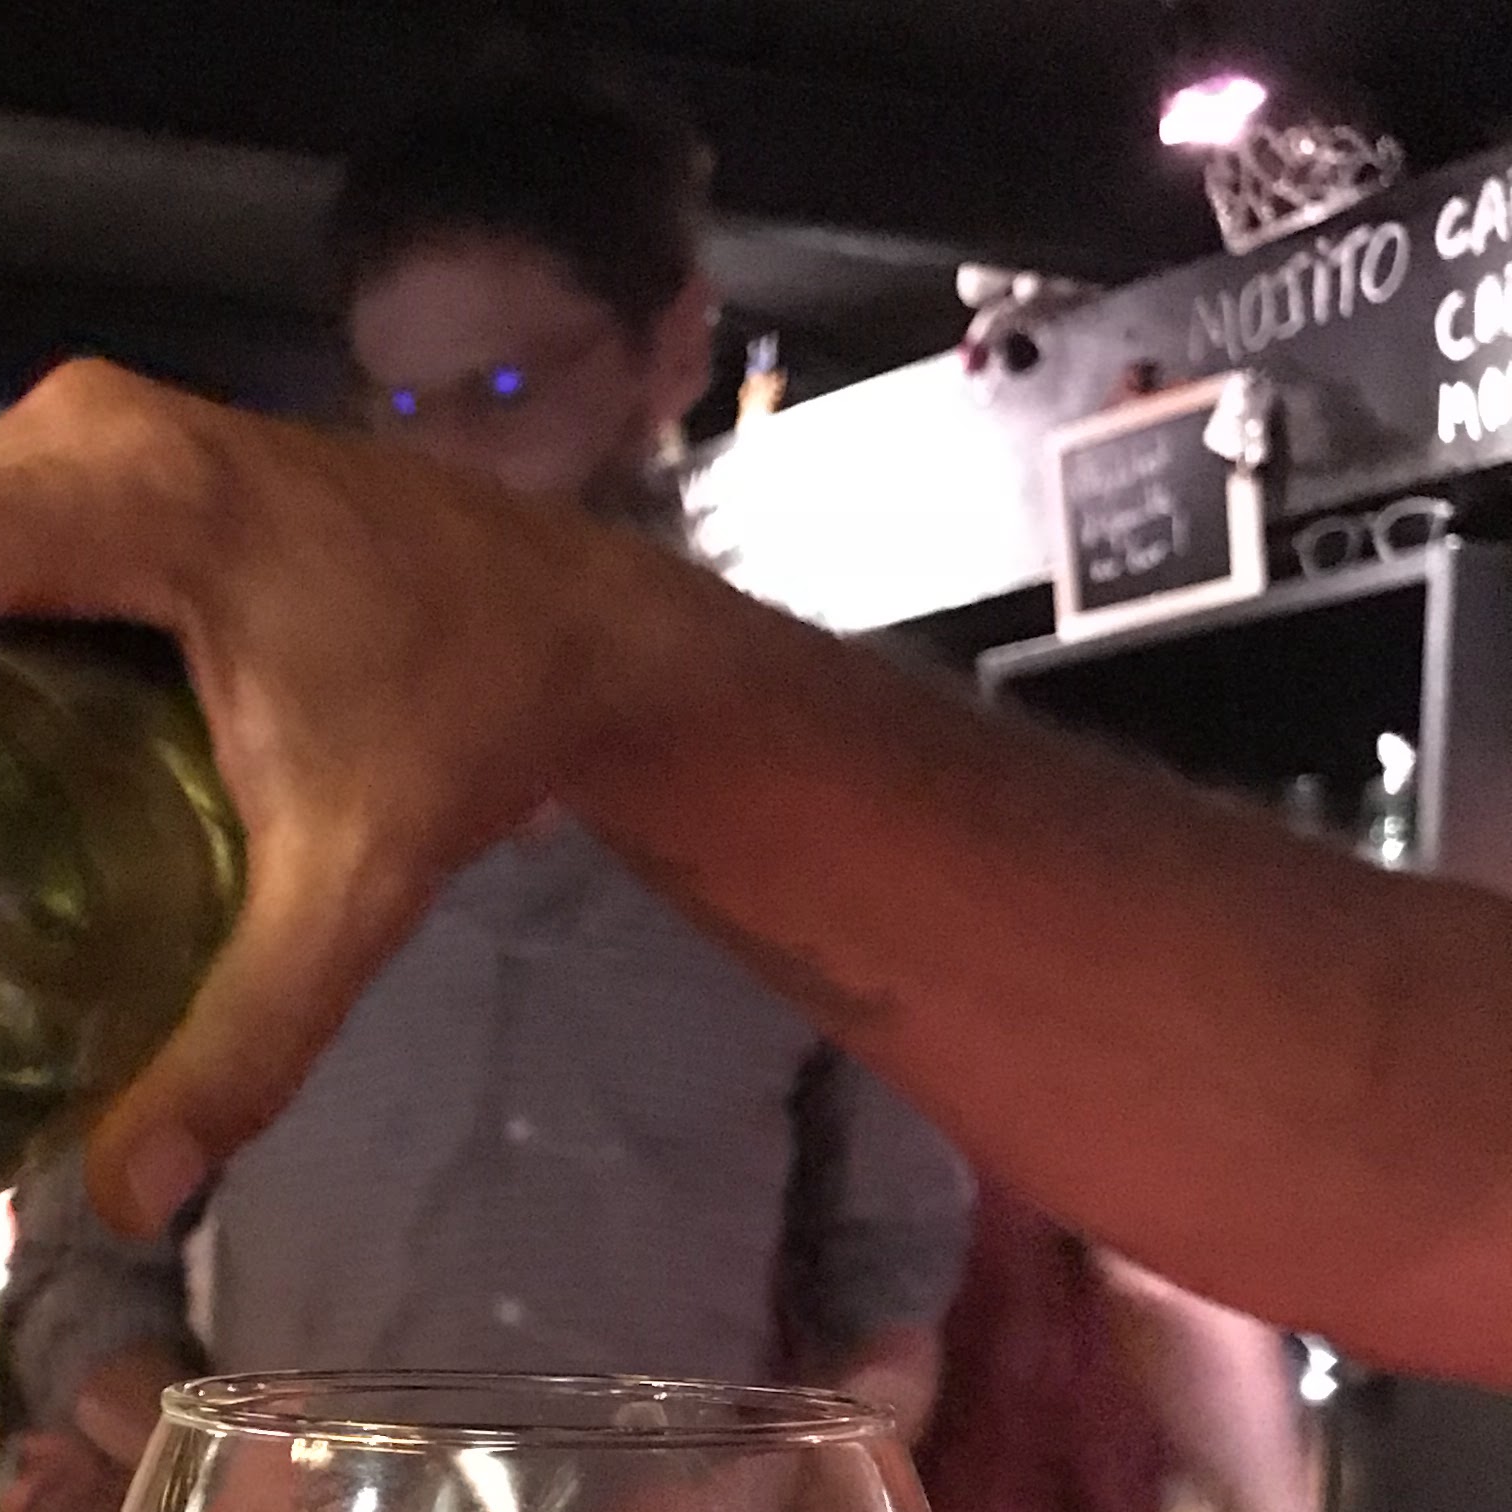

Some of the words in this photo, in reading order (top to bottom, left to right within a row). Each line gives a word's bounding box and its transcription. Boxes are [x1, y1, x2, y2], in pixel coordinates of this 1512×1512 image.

[1435, 168, 1512, 260] CA
[1189, 222, 1410, 363] MOJITO
[1437, 360, 1512, 444] MO
